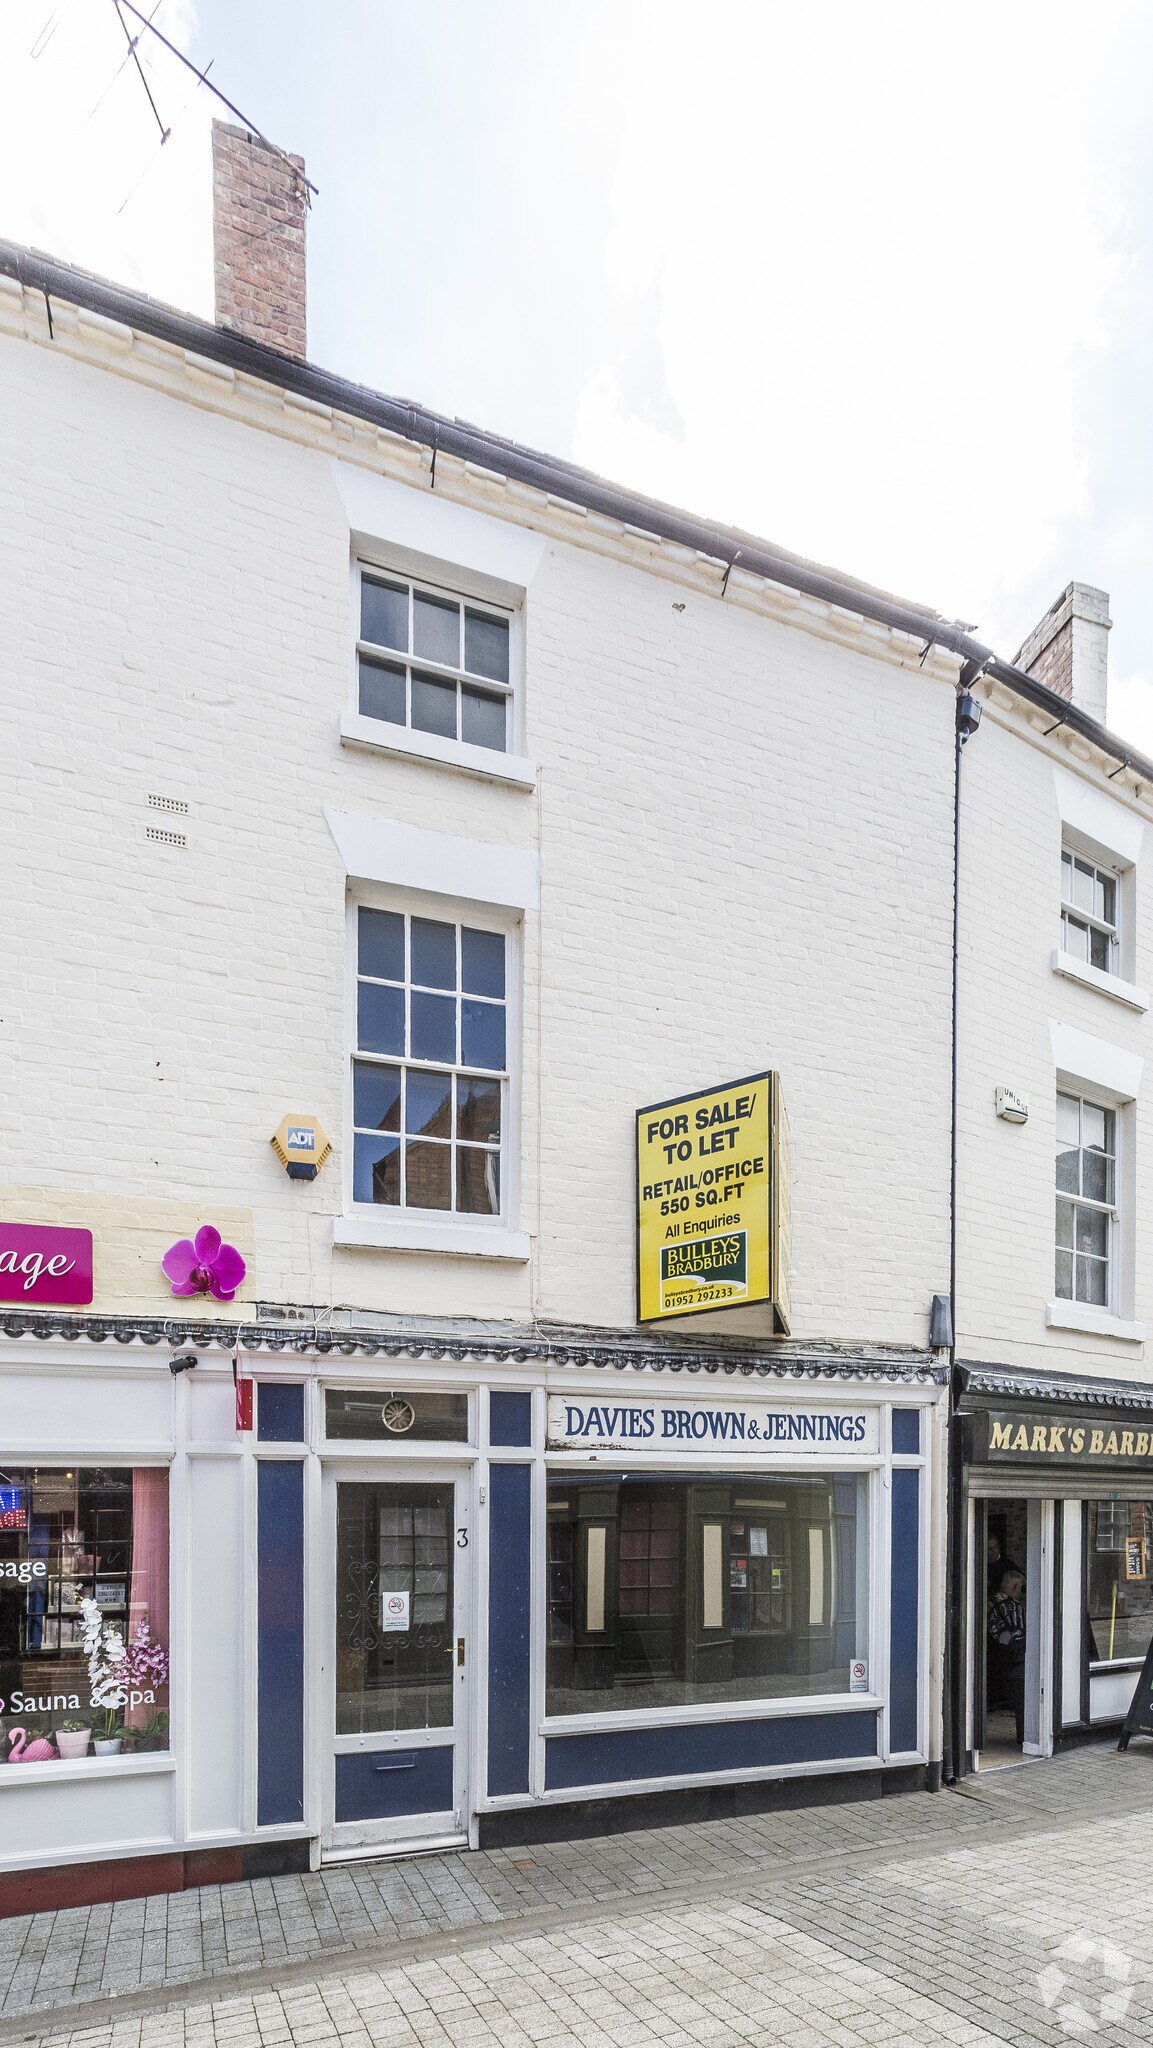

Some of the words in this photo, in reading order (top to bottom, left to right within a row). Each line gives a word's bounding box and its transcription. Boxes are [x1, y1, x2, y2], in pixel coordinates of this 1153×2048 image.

[647, 1114, 689, 1144] FOR
[695, 1092, 757, 1130] SALE/
[288, 1131, 315, 1146] ADT
[663, 1140, 692, 1165] TO
[699, 1126, 740, 1156] LET
[643, 1156, 764, 1201] RETAIL/OFFICE
[660, 1196, 690, 1216] 550
[695, 1182, 745, 1208] SQ.FT
[665, 1223, 680, 1239] All
[684, 1213, 741, 1235] Enquiries
[667, 1235, 741, 1265] BULLEYS
[667, 1251, 740, 1277] BRADBURY
[665, 1294, 694, 1308] 01952
[697, 1287, 733, 1302] 292233
[565, 1406, 655, 1438] DAVIES
[661, 1409, 746, 1440] BROWN
[748, 1419, 761, 1440] &
[763, 1413, 867, 1442] JENNINGS
[989, 1421, 1086, 1454] MARK'S
[457, 1528, 468, 1547] 3
[10, 1691, 81, 1713] Sauna
[116, 1684, 156, 1711] Spa
